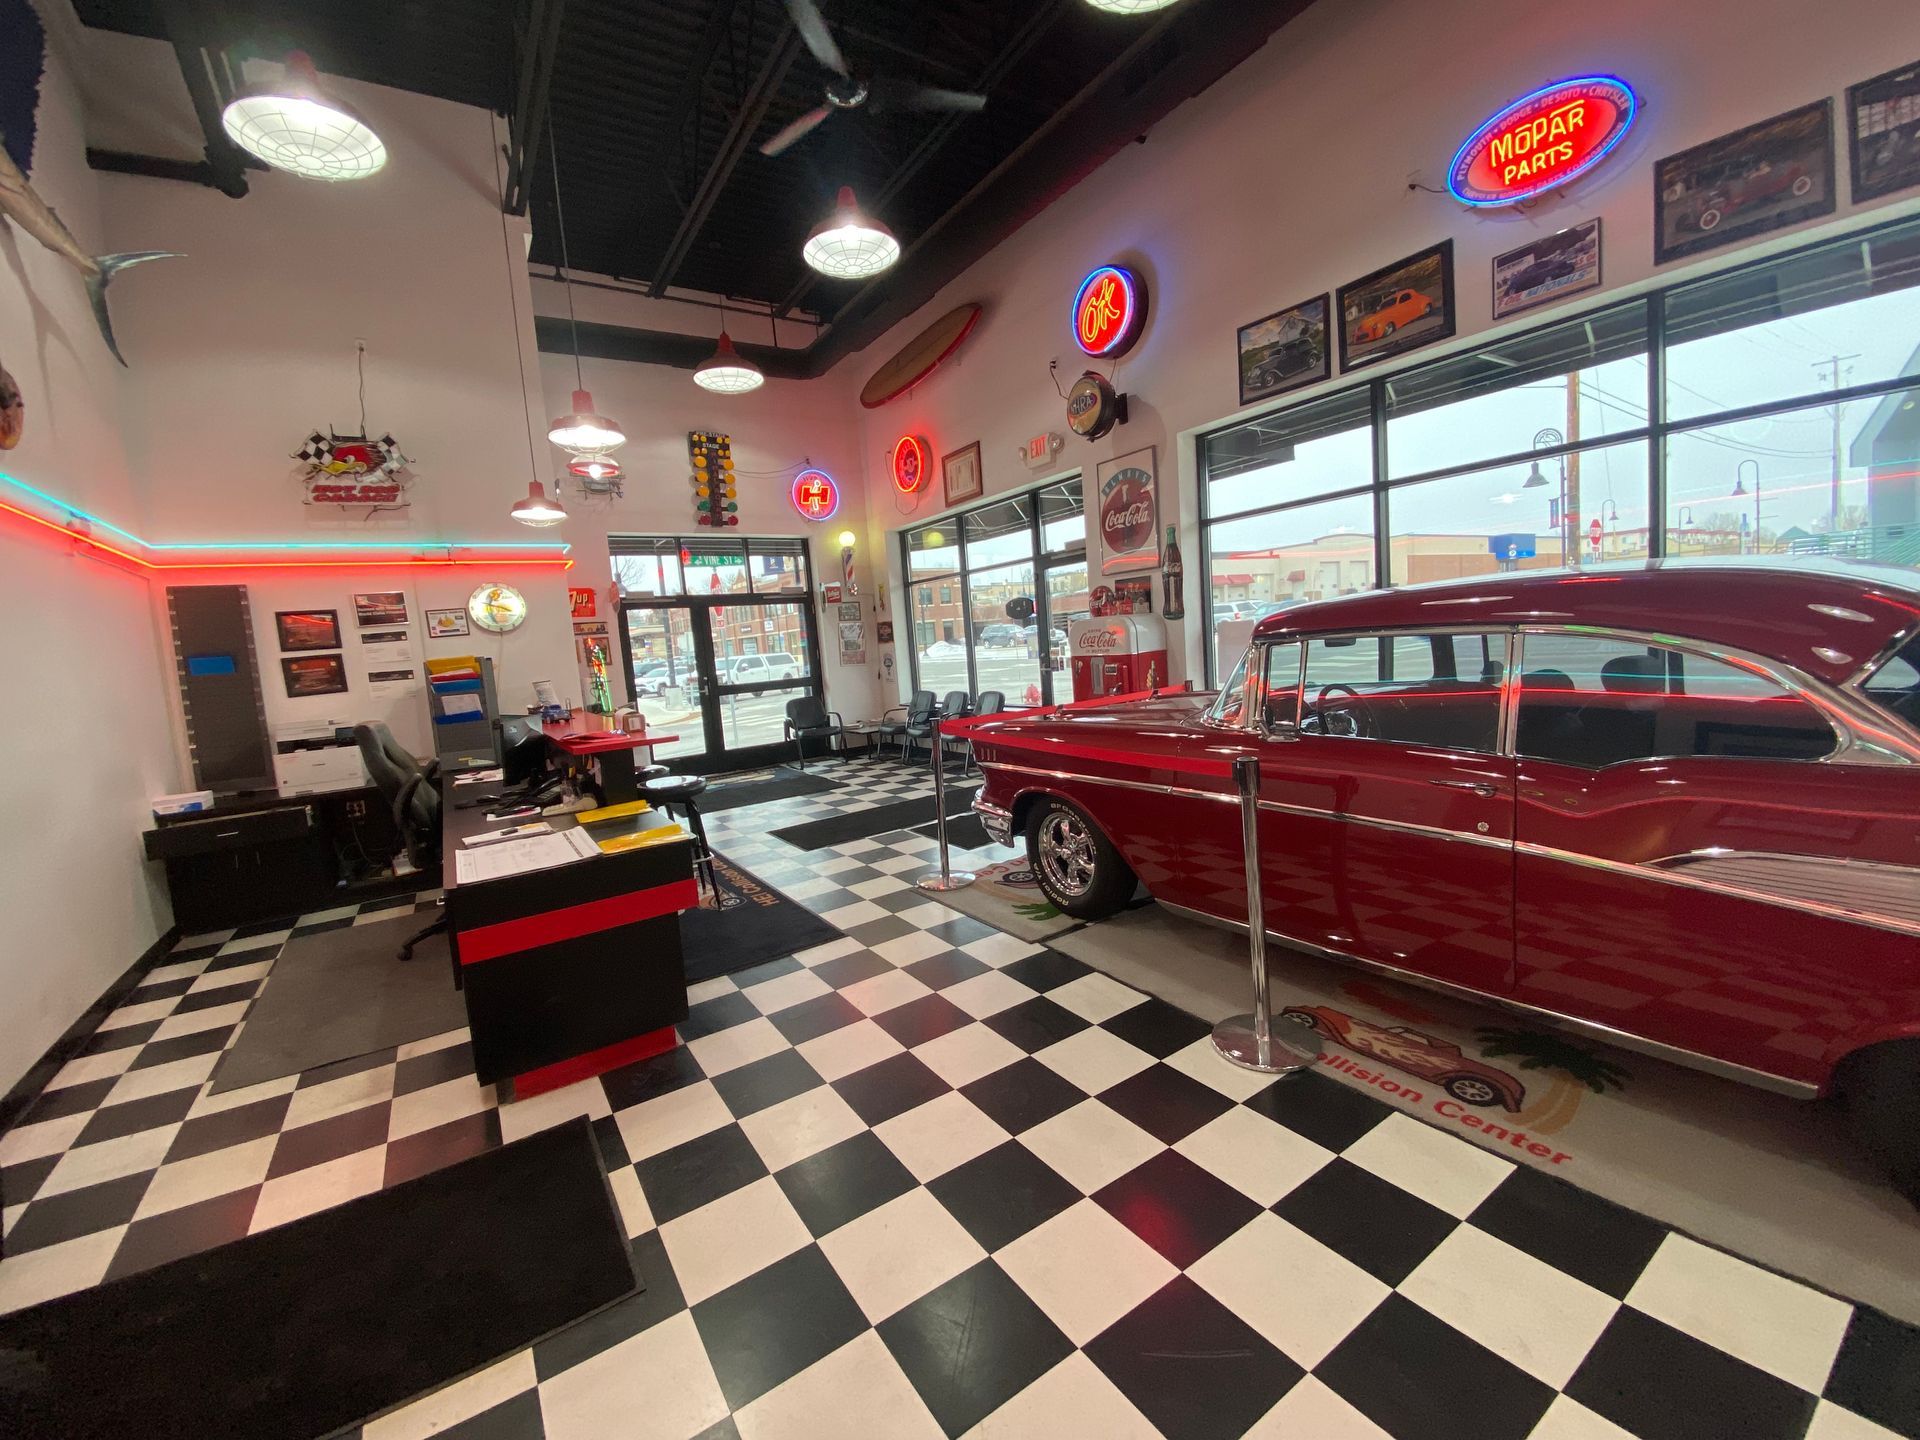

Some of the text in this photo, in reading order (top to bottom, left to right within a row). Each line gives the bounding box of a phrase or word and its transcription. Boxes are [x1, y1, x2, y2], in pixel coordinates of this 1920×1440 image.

[1456, 86, 1629, 181] PLYMOUTH DODGE DESOTO CHRYSLER
[1490, 99, 1585, 168] MOPAR
[1503, 141, 1573, 186] PARTS
[1030, 435, 1047, 460] EXIT
[1103, 469, 1149, 493] ALWAYS
[1105, 501, 1150, 532] Coca-Cola
[1079, 630, 1117, 648] Coca-Cola
[1315, 1052, 1573, 1165] ollision Center
